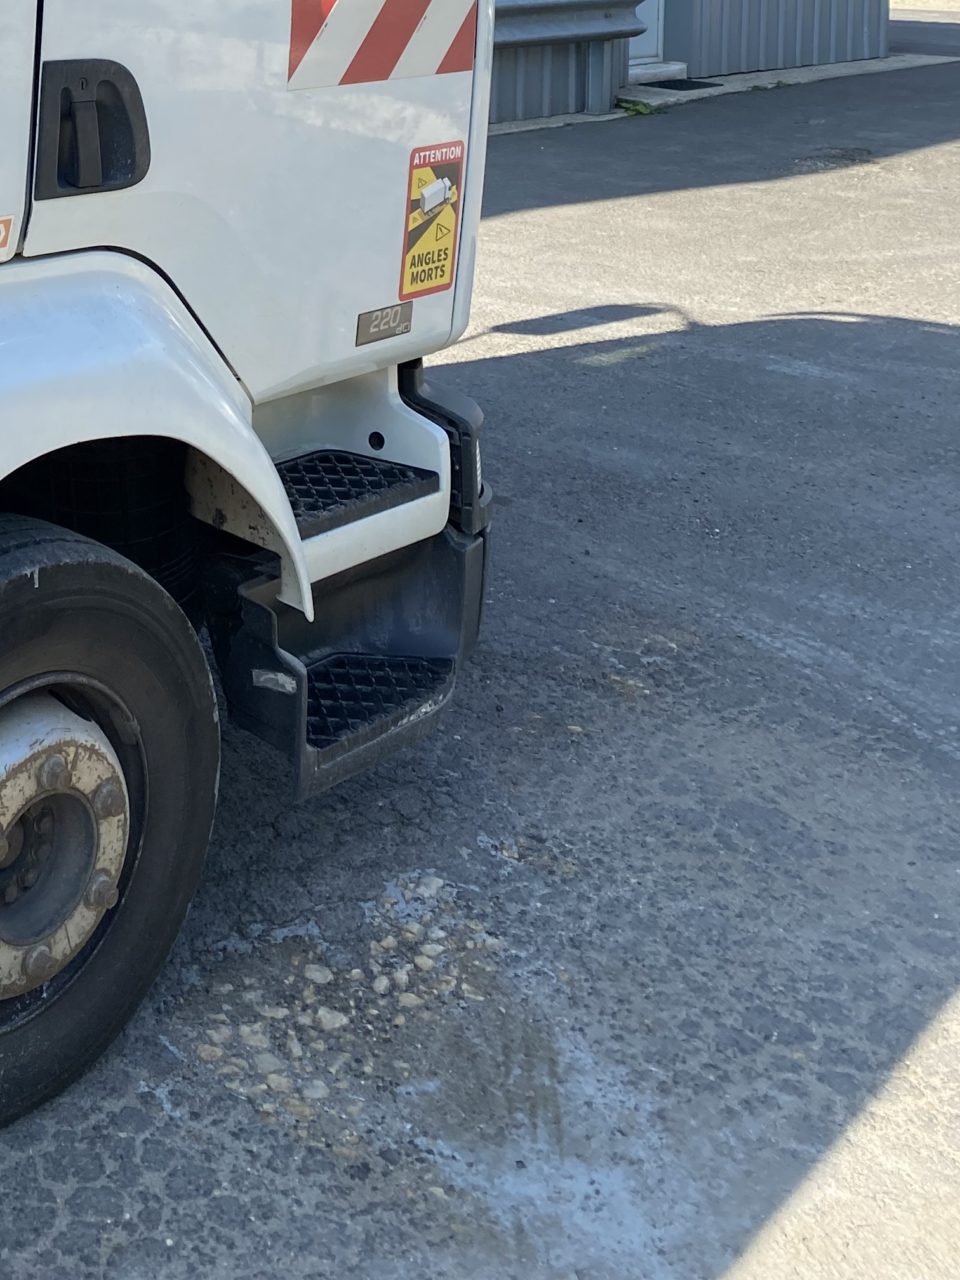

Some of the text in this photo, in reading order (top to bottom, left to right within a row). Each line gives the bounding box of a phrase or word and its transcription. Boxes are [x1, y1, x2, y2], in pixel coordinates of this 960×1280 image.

[413, 145, 462, 166] ATTENTION
[409, 247, 449, 270] ANGLES
[410, 264, 446, 286] MORTS
[369, 305, 402, 333] 220
